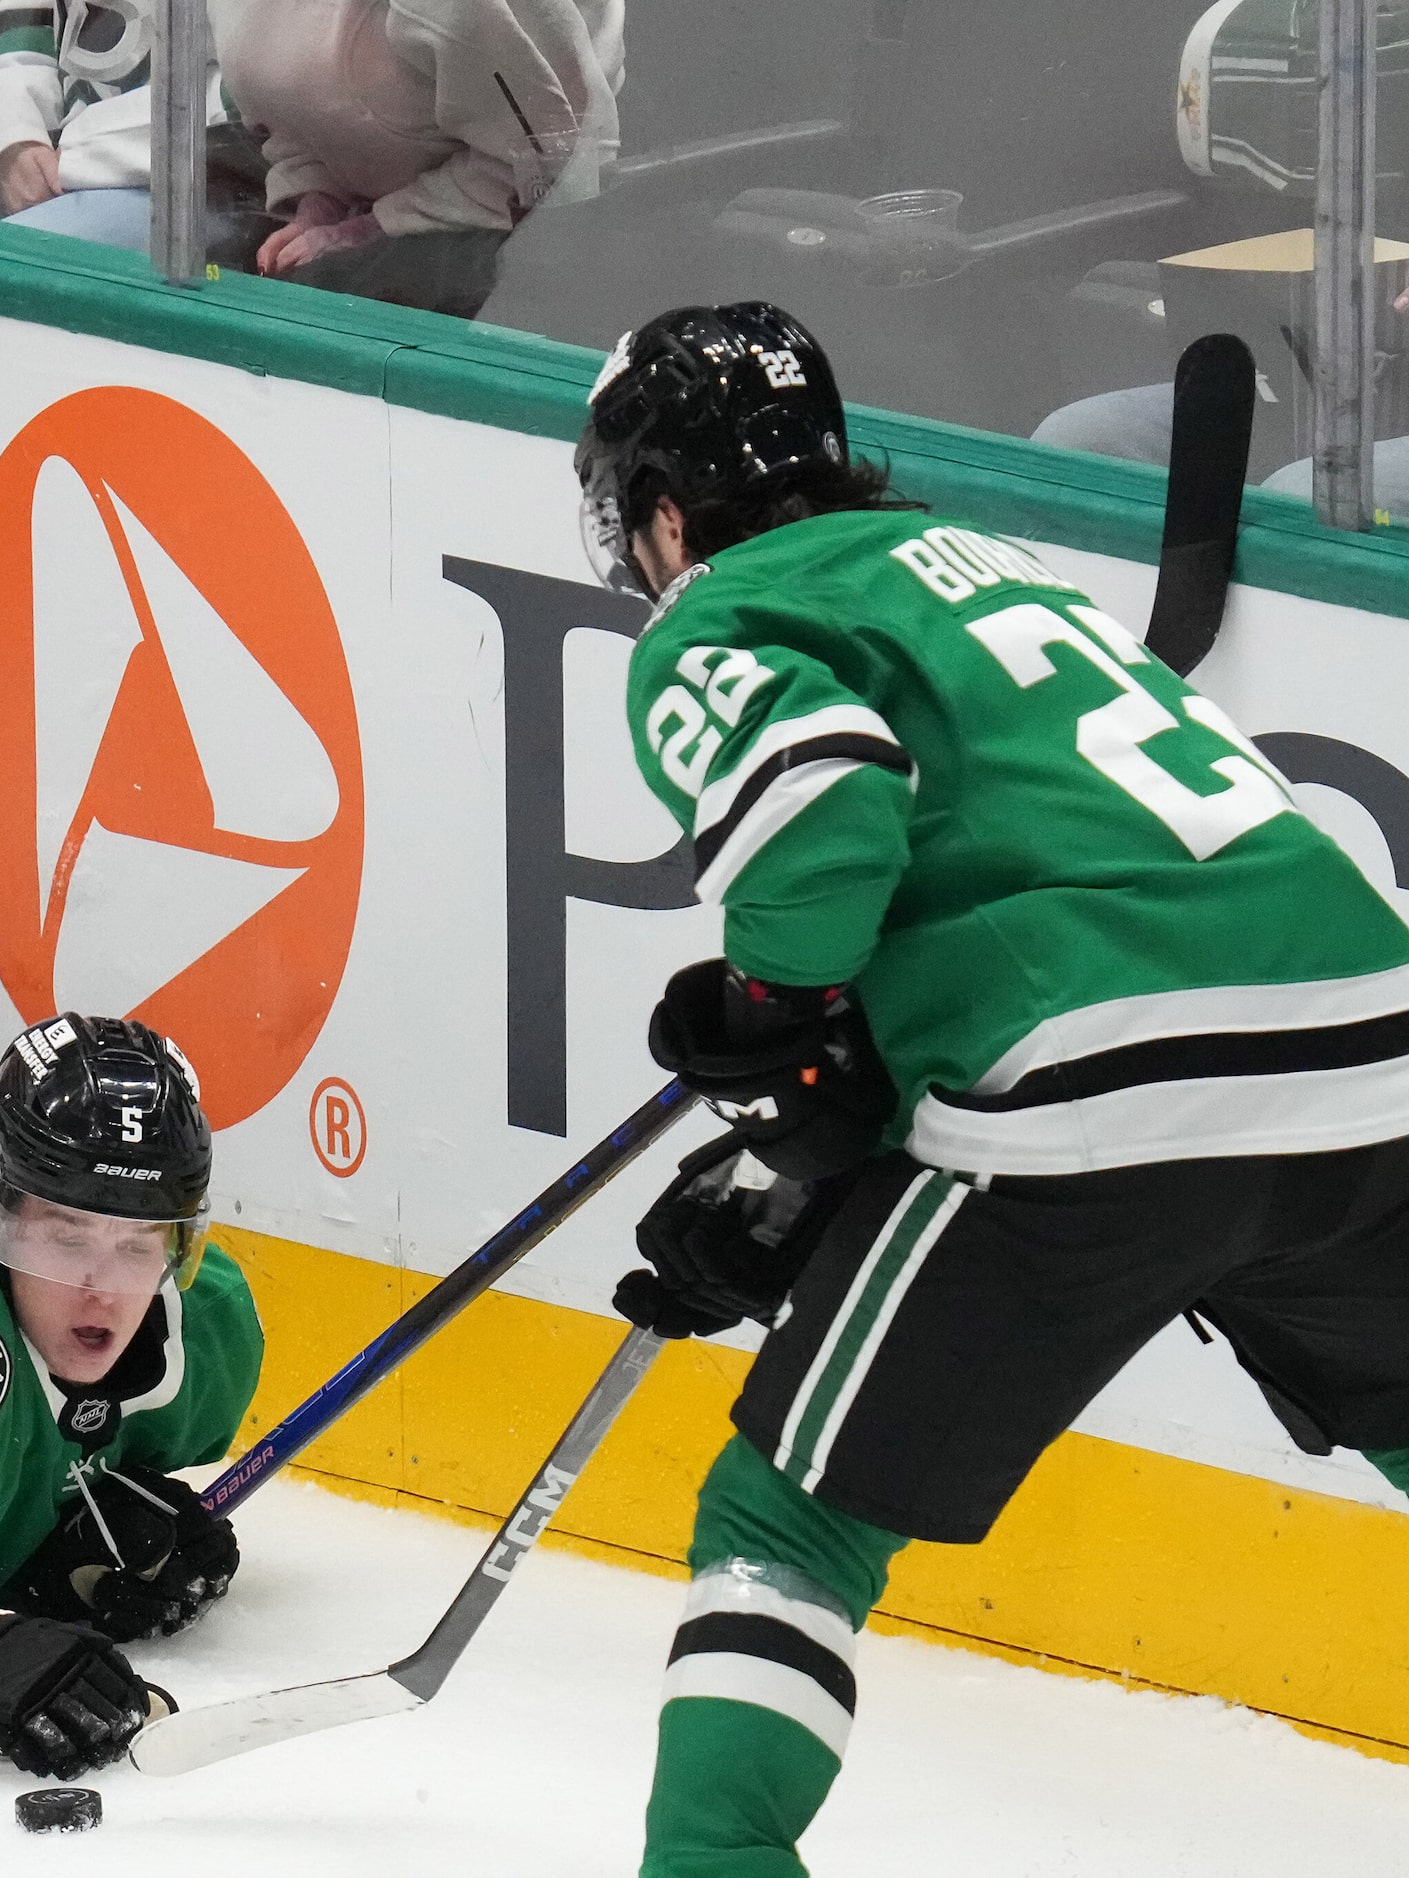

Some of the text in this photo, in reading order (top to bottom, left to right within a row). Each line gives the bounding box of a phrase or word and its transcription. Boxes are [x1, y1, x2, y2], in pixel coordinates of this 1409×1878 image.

[757, 350, 807, 389] 22
[122, 1107, 143, 1143] 5
[482, 1463, 578, 1582] CCM
